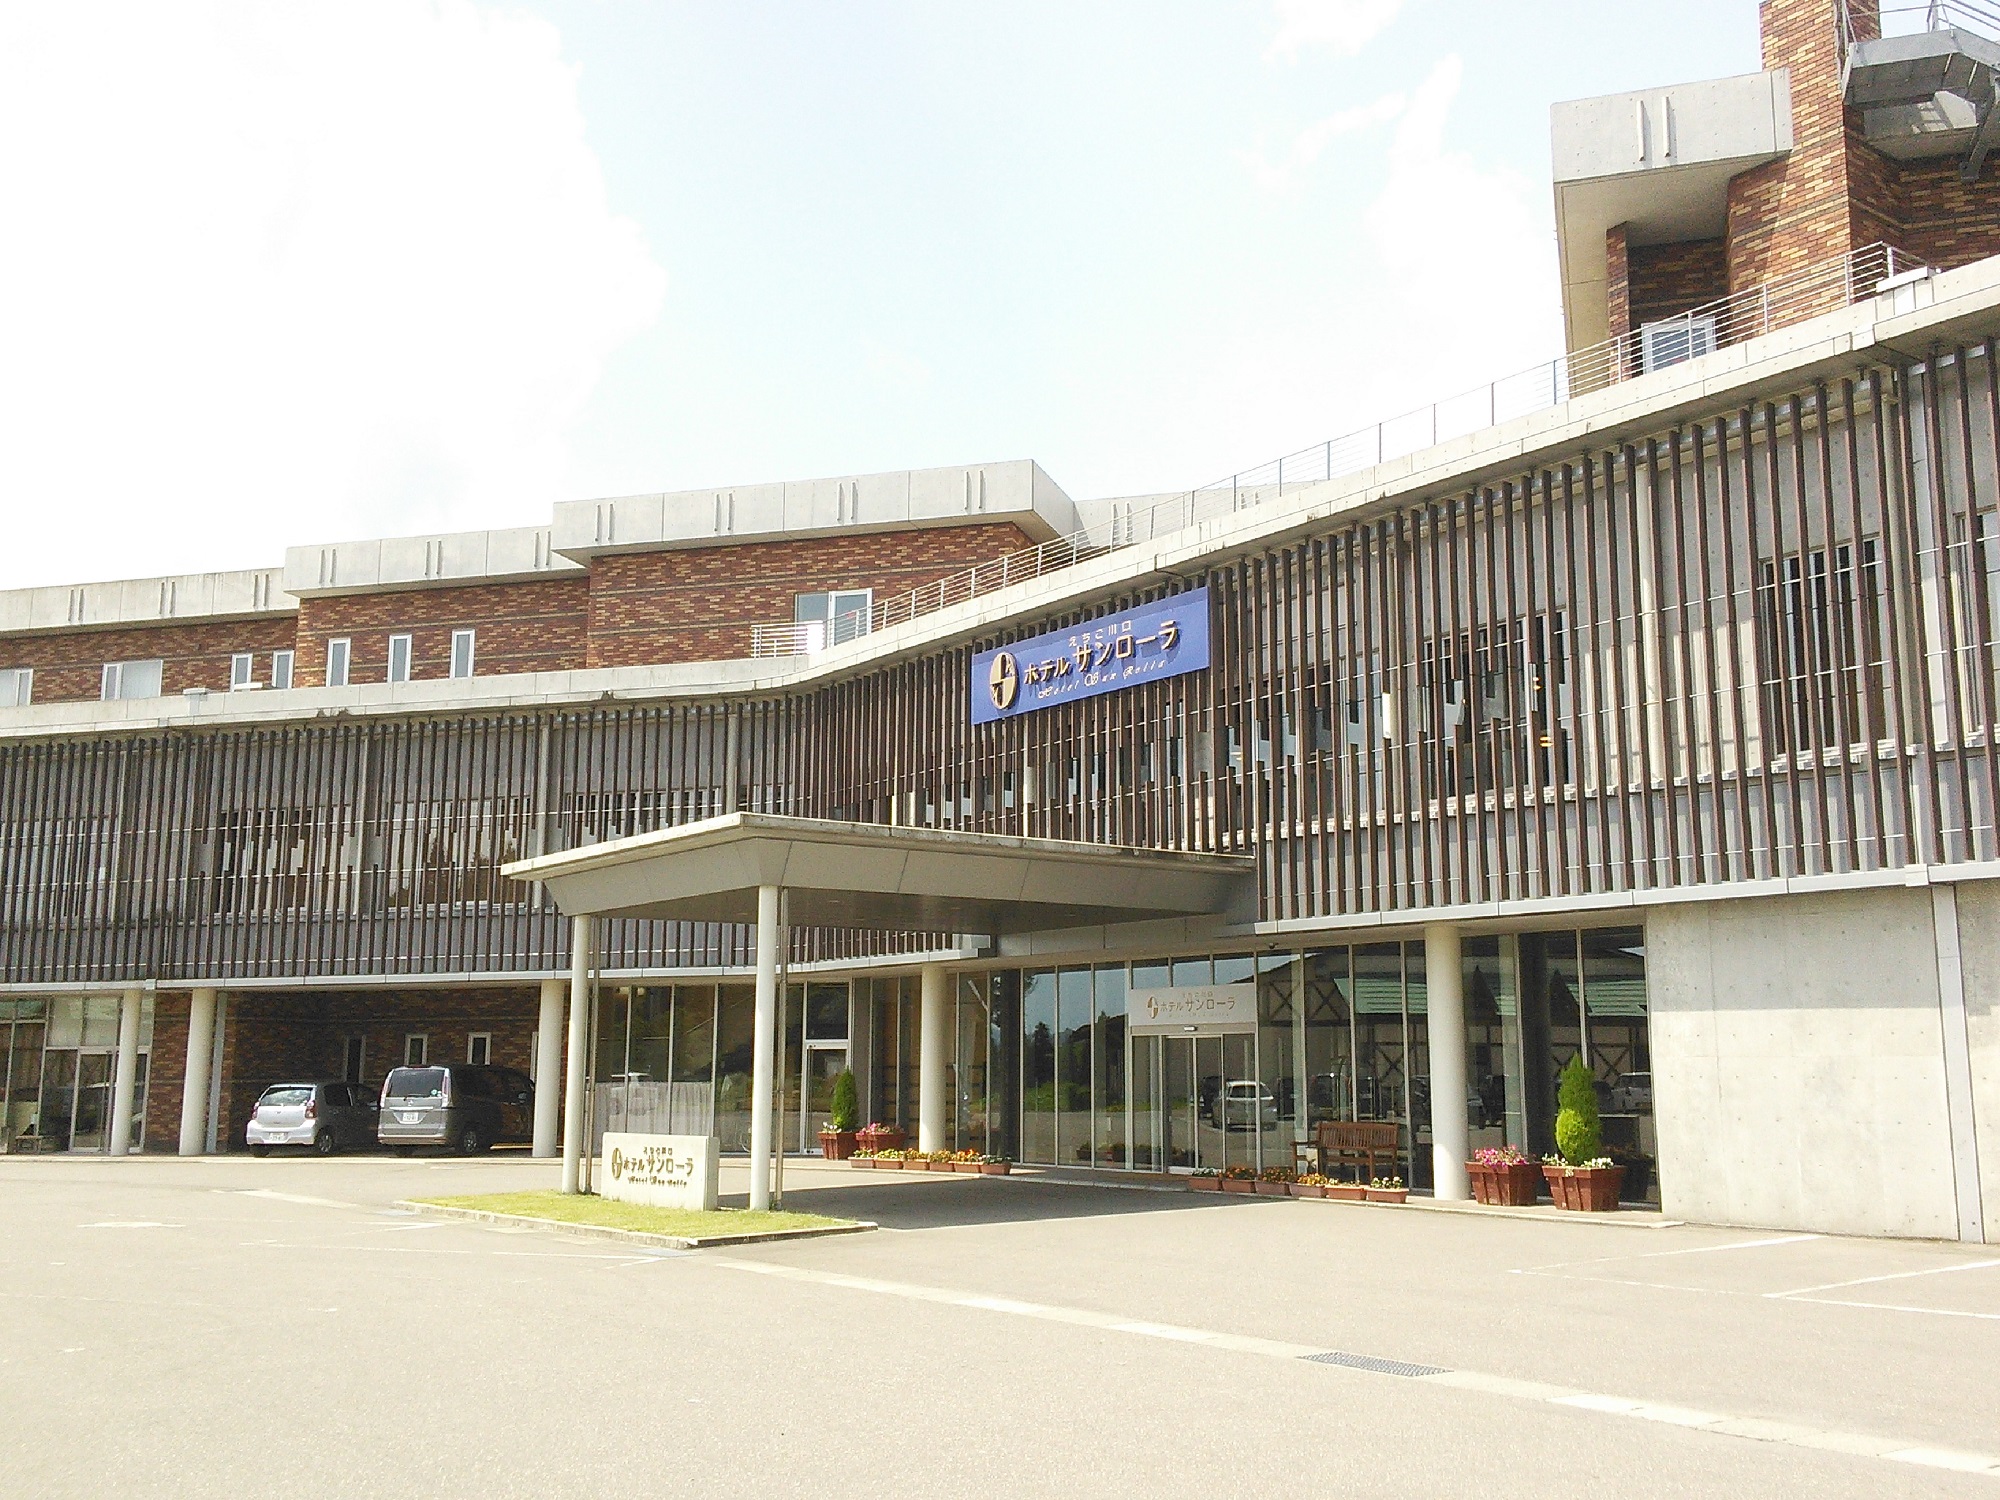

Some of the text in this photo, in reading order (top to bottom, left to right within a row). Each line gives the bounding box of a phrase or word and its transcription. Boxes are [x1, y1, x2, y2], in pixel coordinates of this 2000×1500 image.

[1069, 620, 1132, 647] えちご川口
[1024, 620, 1179, 685] ホテルサンローラ
[1038, 680, 1079, 699] Hotel
[623, 1155, 694, 1178] ホテルサンローラ
